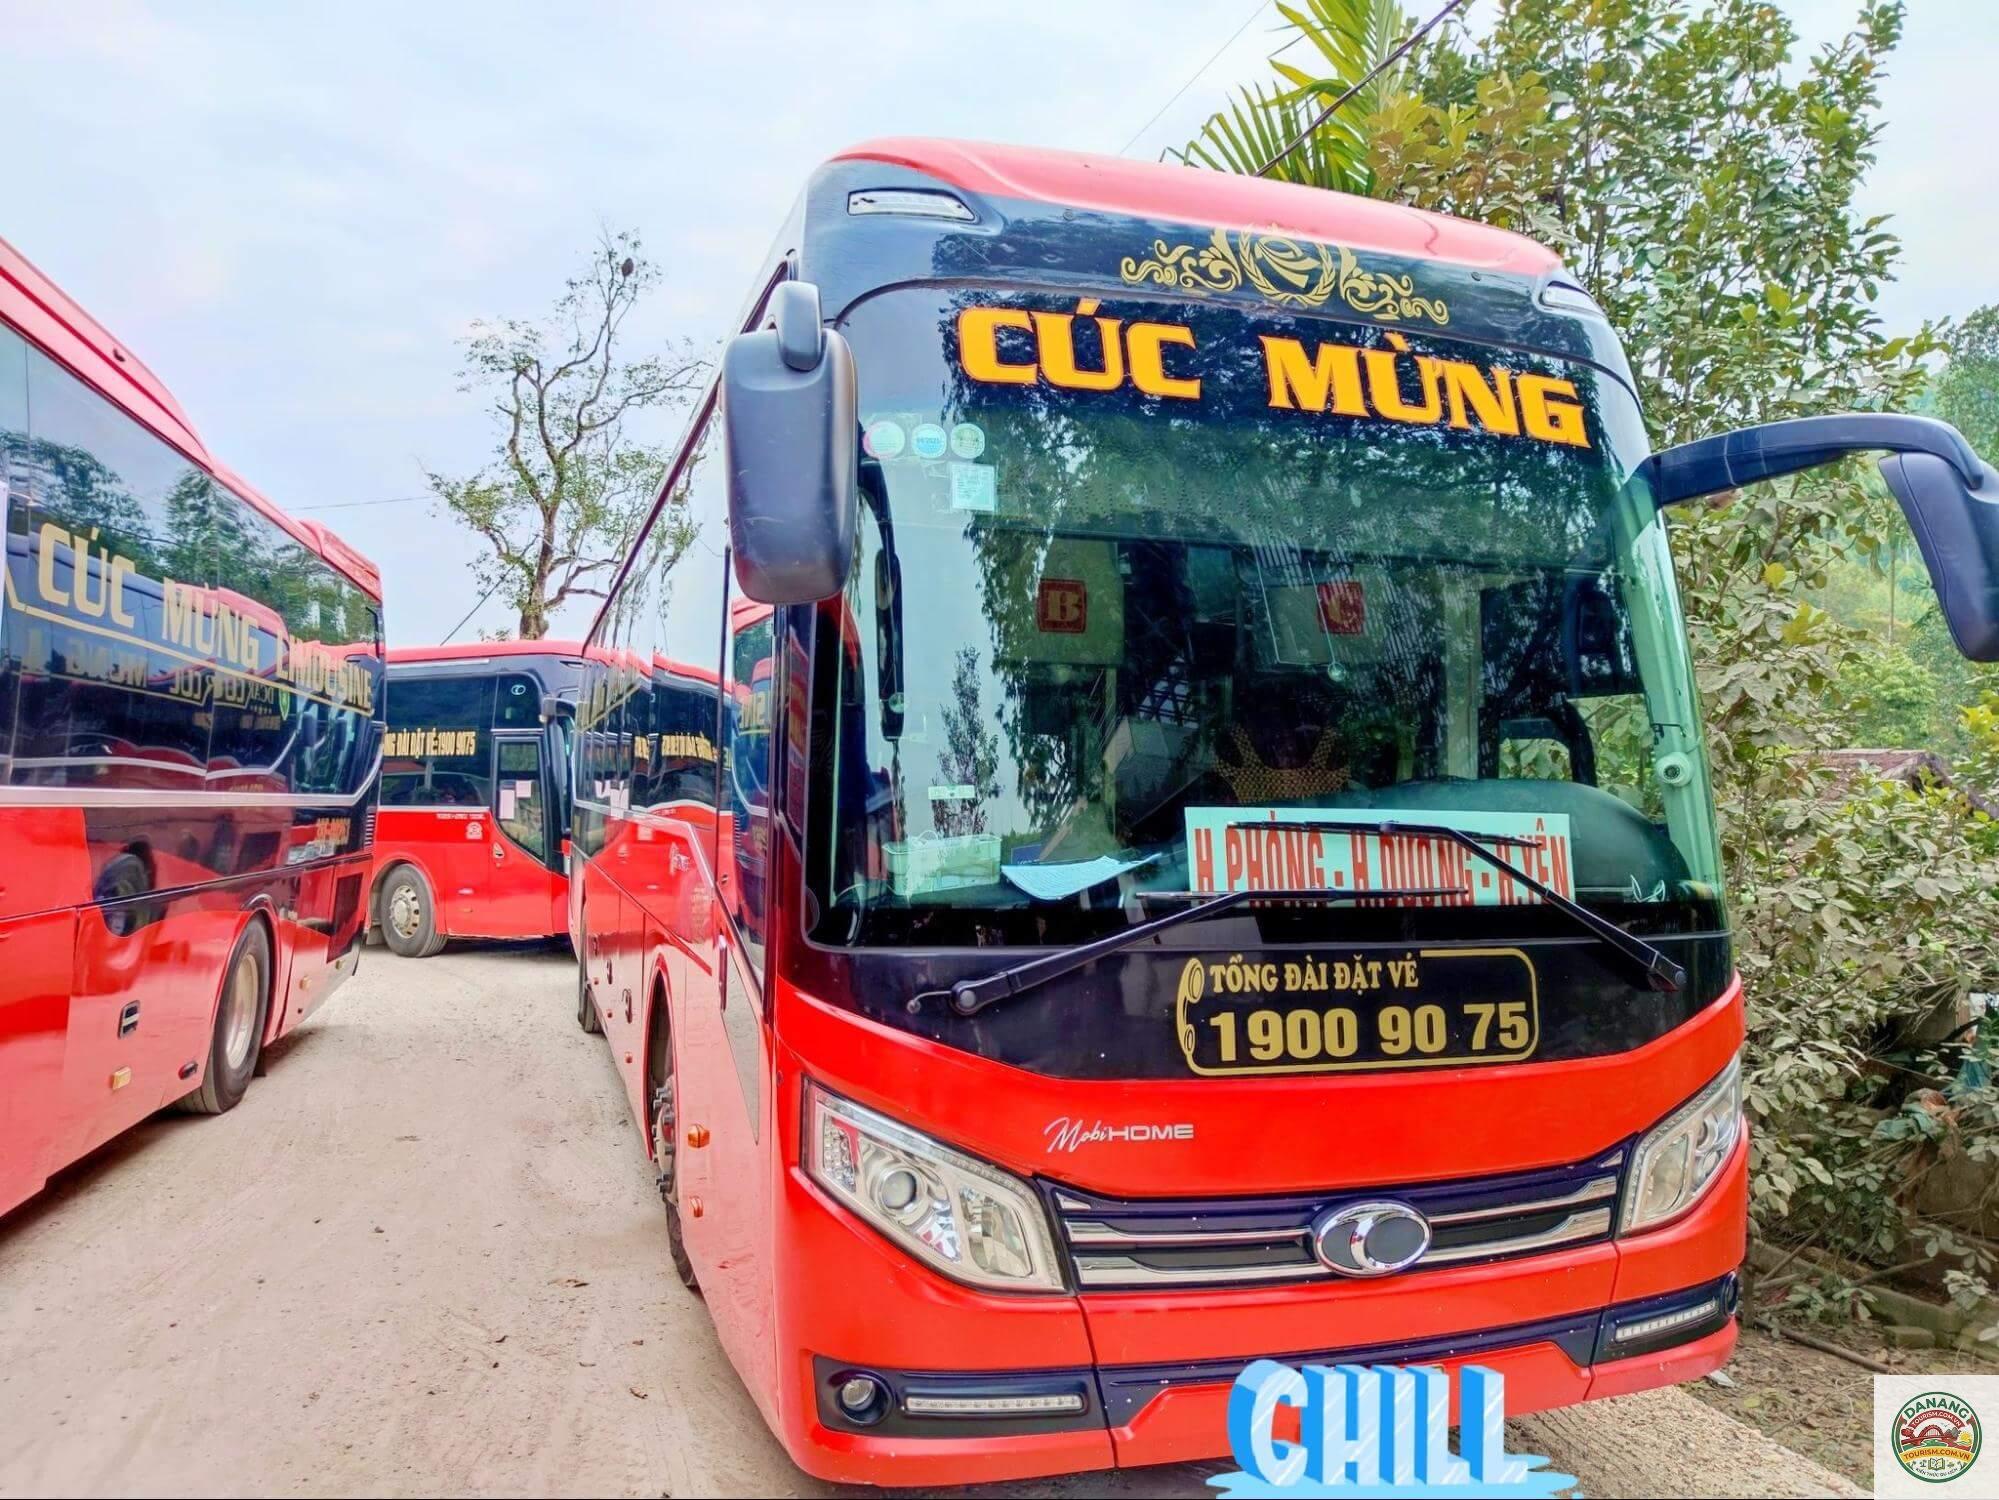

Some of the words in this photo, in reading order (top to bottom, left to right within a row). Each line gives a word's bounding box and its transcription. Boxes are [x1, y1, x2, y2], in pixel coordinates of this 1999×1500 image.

[957, 298, 1201, 400] CÚC
[1259, 332, 1592, 449] MỪNG
[38, 521, 136, 629] CÚC
[1210, 953, 1279, 993] TỔNG
[1284, 955, 1329, 991] ĐÀI
[1334, 954, 1382, 995] ĐẶT
[1387, 952, 1419, 988] VÉ
[1209, 1007, 1358, 1062] 1900
[1378, 1004, 1447, 1053] 90
[1463, 1001, 1530, 1050] 75
